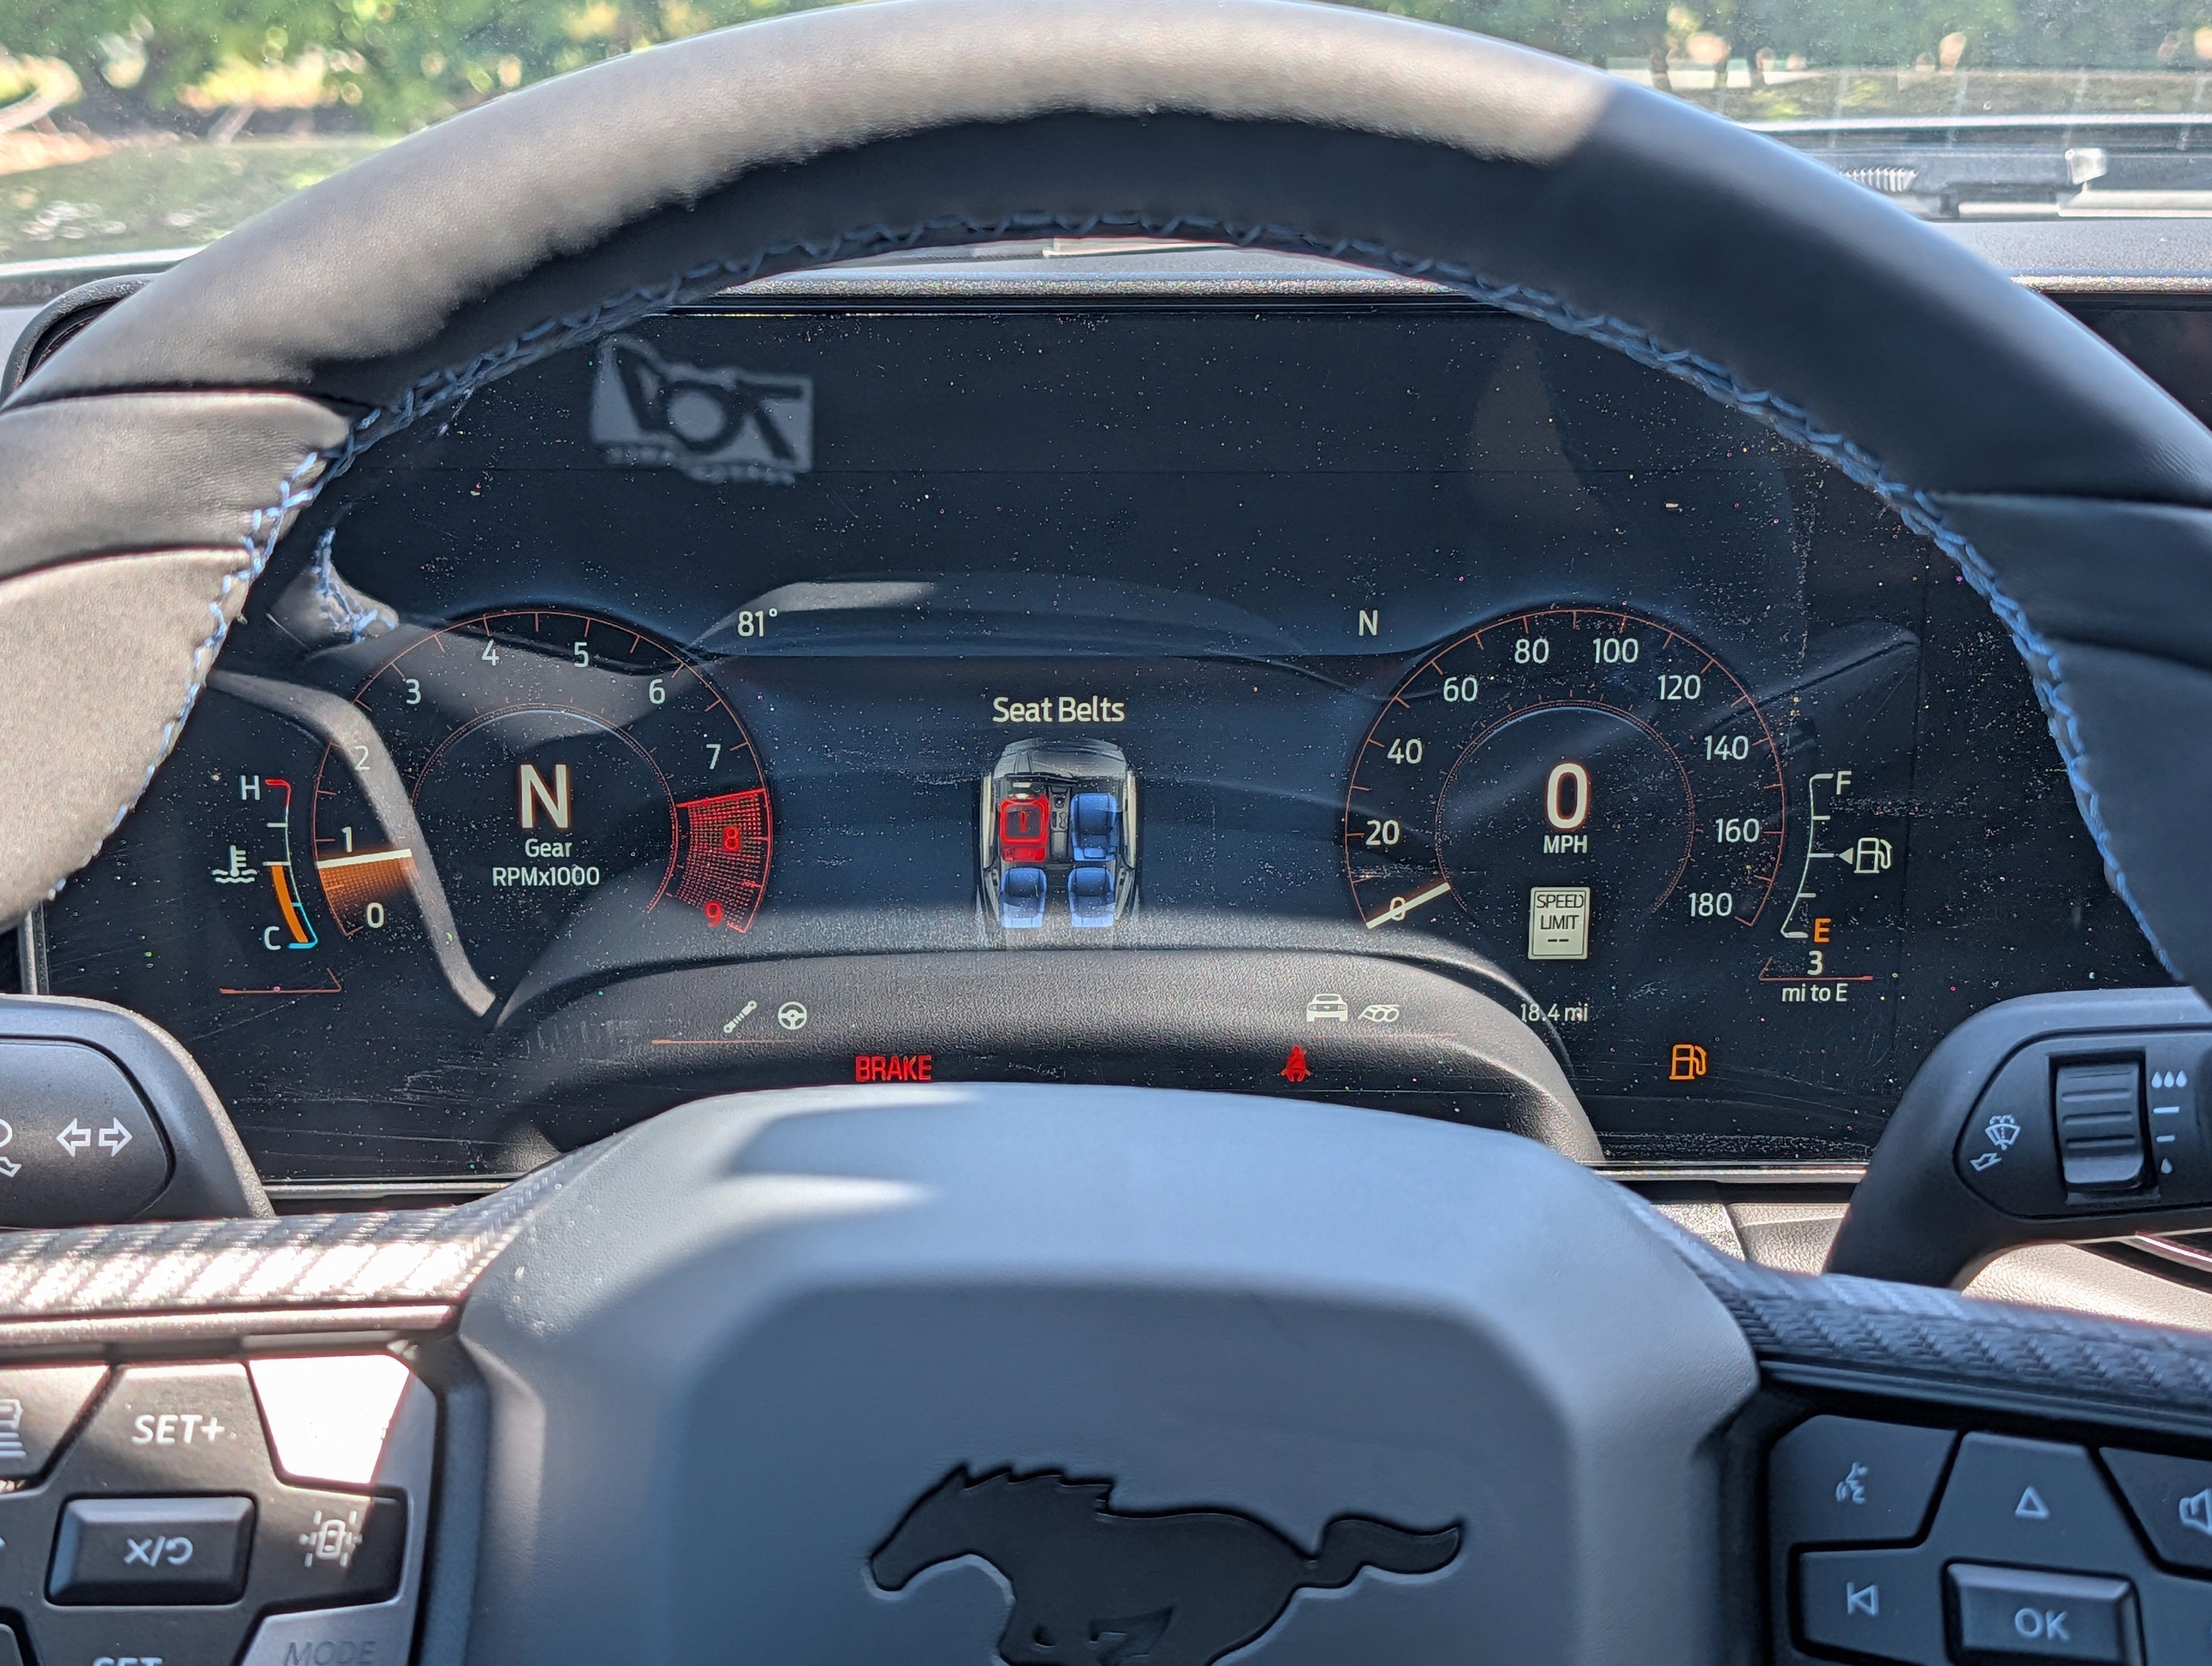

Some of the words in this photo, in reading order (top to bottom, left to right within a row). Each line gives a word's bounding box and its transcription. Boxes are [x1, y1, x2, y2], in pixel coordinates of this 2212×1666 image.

[1358, 611, 1379, 636] N
[480, 641, 500, 666] 4
[573, 642, 589, 668] 5
[1514, 639, 1549, 664] 80
[1592, 639, 1638, 664] 100
[406, 679, 422, 704] 3
[648, 679, 665, 704] 6
[1443, 677, 1478, 702] 60
[1657, 676, 1701, 700] 120
[992, 697, 1053, 723] Seat
[1058, 695, 1126, 723] Belts
[355, 746, 370, 771] 2
[706, 745, 721, 769] 7
[1387, 739, 1423, 764] 40
[1706, 736, 1749, 760] 140
[240, 775, 260, 801] H
[1836, 771, 1851, 794] F
[519, 764, 568, 829] N
[1546, 763, 1587, 829] 0
[343, 828, 352, 853] 1
[723, 828, 738, 850] 8
[1366, 821, 1400, 845] 20
[1716, 819, 1760, 843] 160
[525, 838, 572, 858] Gear
[1544, 835, 1587, 854] MPH
[492, 867, 600, 887] RPMx1000
[1536, 894, 1584, 909] SPEED
[1689, 892, 1733, 917] 180
[366, 903, 384, 928] 0
[705, 902, 722, 927] 9
[1541, 914, 1579, 931] LIMIT
[264, 927, 281, 950] C
[1814, 918, 1831, 943] E
[1807, 951, 1823, 975] 3
[1782, 983, 1806, 1002] mi
[1810, 984, 1831, 1002] to
[1836, 983, 1848, 1002] E
[1520, 1004, 1560, 1021] 18.4
[1564, 1003, 1588, 1021] mi
[855, 1055, 932, 1082] BRAKE
[132, 1415, 224, 1444] SET+
[2015, 1607, 2071, 1641] OK
